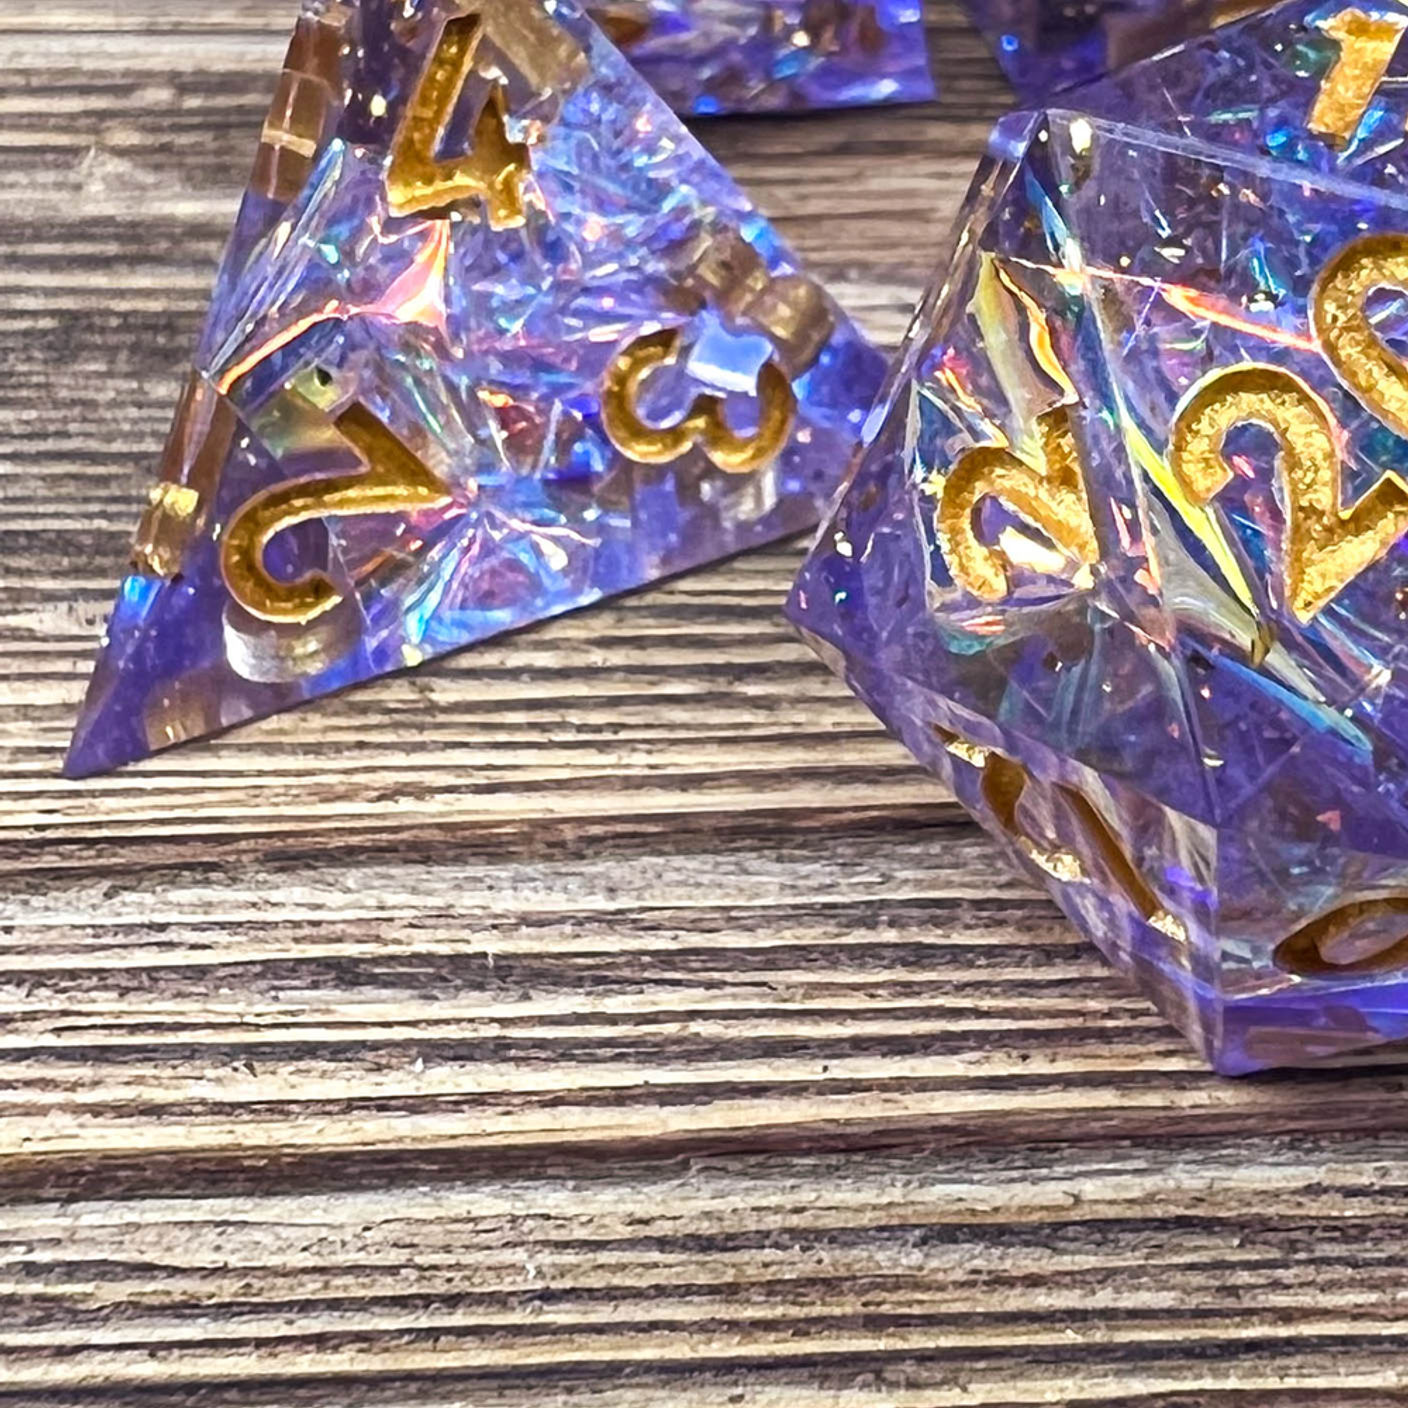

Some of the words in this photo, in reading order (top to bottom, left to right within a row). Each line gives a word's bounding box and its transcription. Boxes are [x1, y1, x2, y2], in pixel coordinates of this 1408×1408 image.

[385, 11, 532, 230] 4
[600, 327, 795, 473] 3
[221, 404, 454, 623] 2
